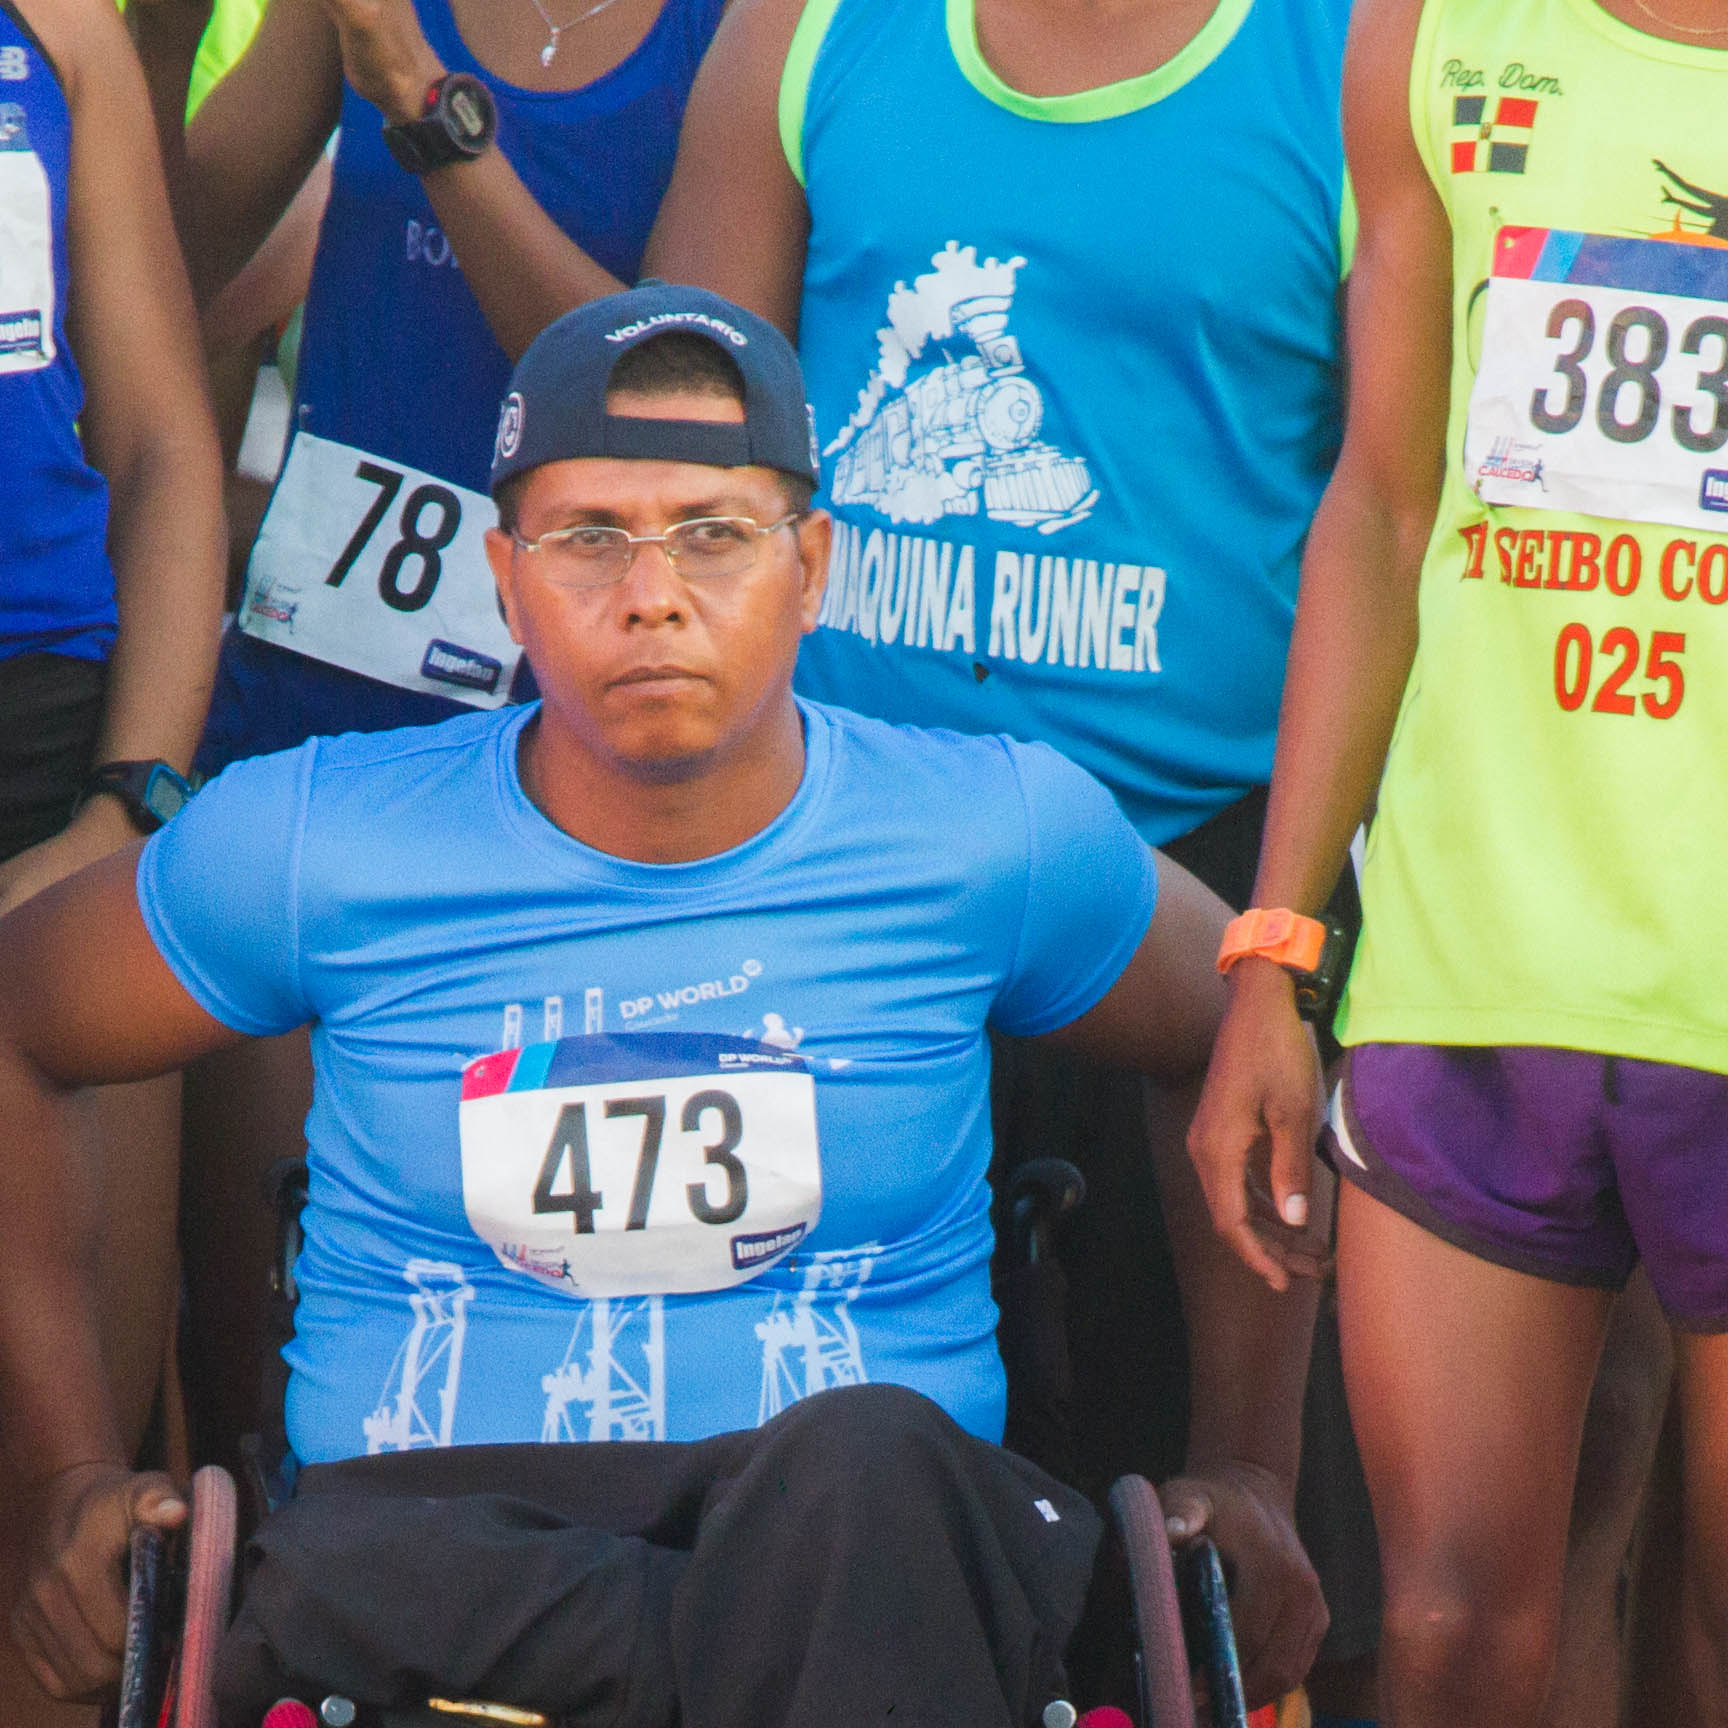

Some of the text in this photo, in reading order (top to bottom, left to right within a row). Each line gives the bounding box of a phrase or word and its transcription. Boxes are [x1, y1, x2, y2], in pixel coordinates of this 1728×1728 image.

[604, 311, 749, 348] VOLUNTARIO
[325, 461, 462, 614] 78
[1494, 526, 1642, 597] SEIBO
[988, 550, 1167, 673] RUNNER
[1553, 622, 1686, 720] 025
[619, 975, 749, 1020] DP WORLD
[718, 1053, 737, 1063] DP
[531, 1089, 749, 1235] 473
